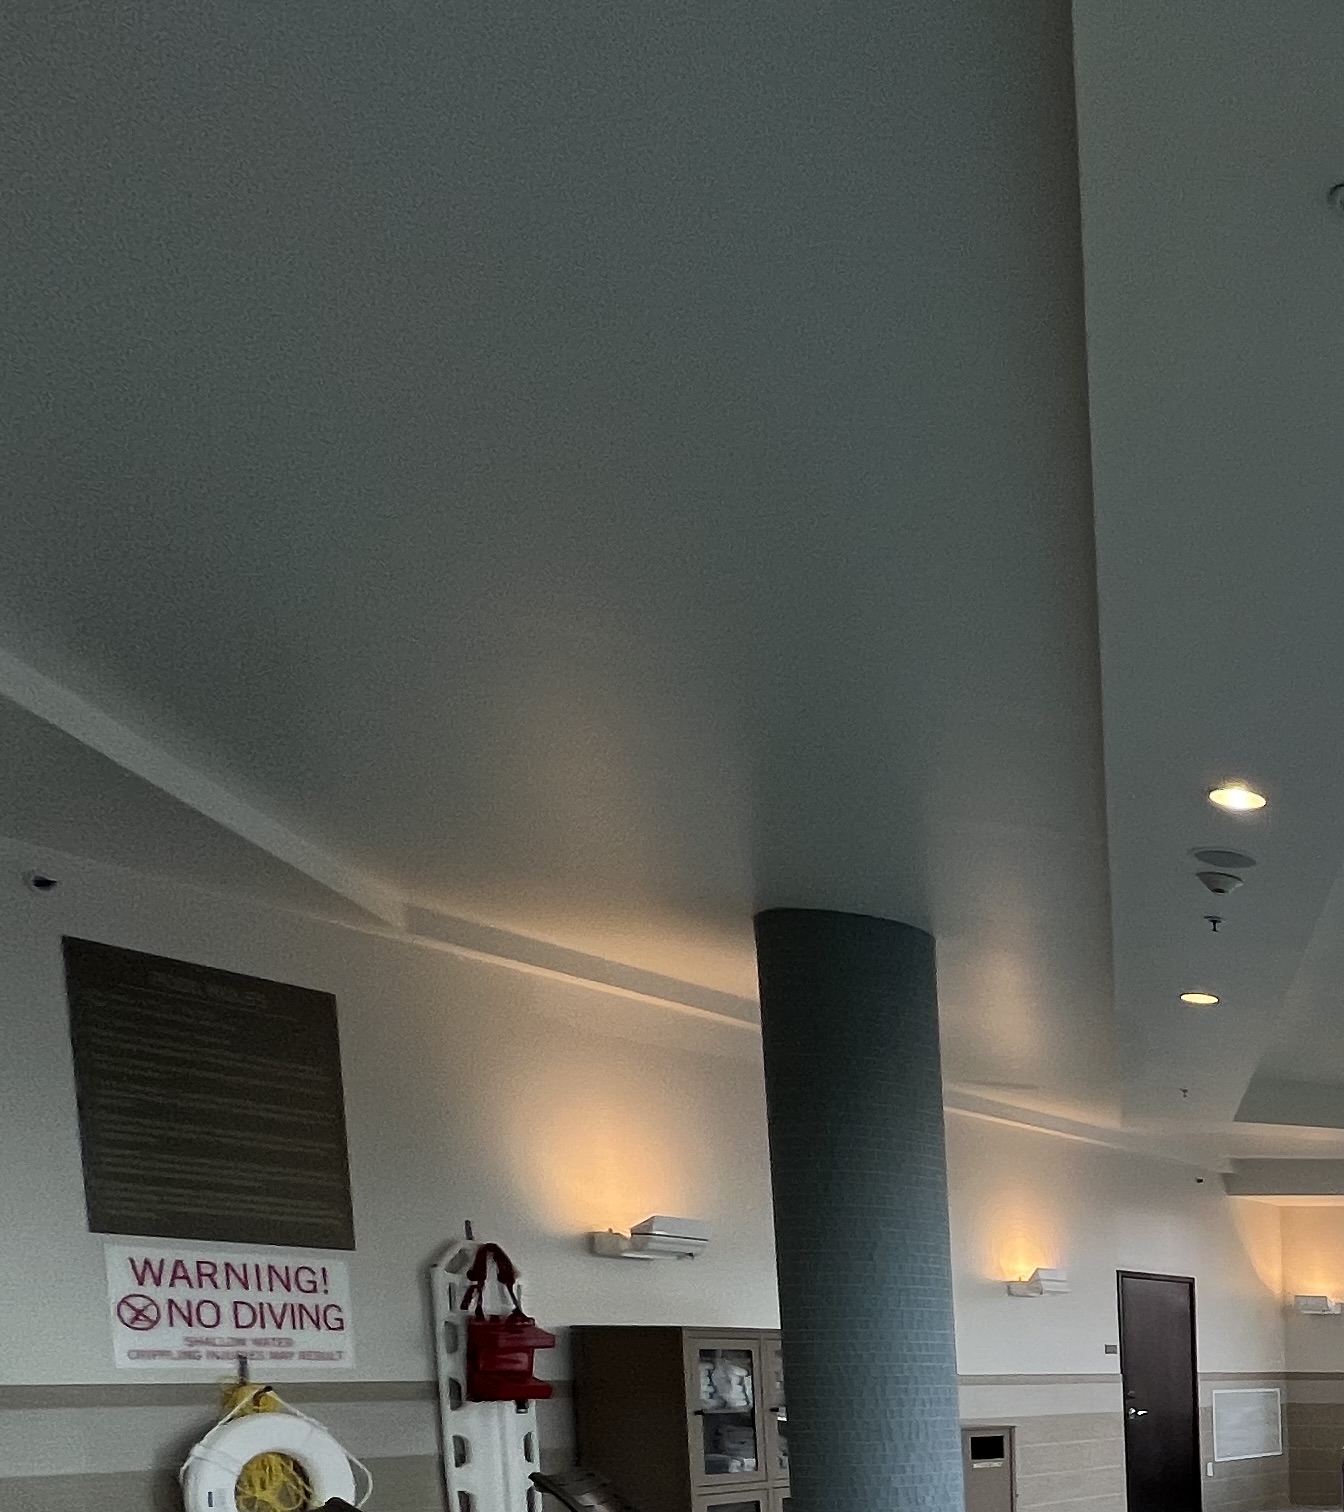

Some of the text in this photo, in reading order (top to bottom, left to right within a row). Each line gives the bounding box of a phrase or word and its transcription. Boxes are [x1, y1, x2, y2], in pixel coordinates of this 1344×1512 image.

[128, 1257, 329, 1295] WARNING!
[167, 1299, 345, 1331] NO DIVING
